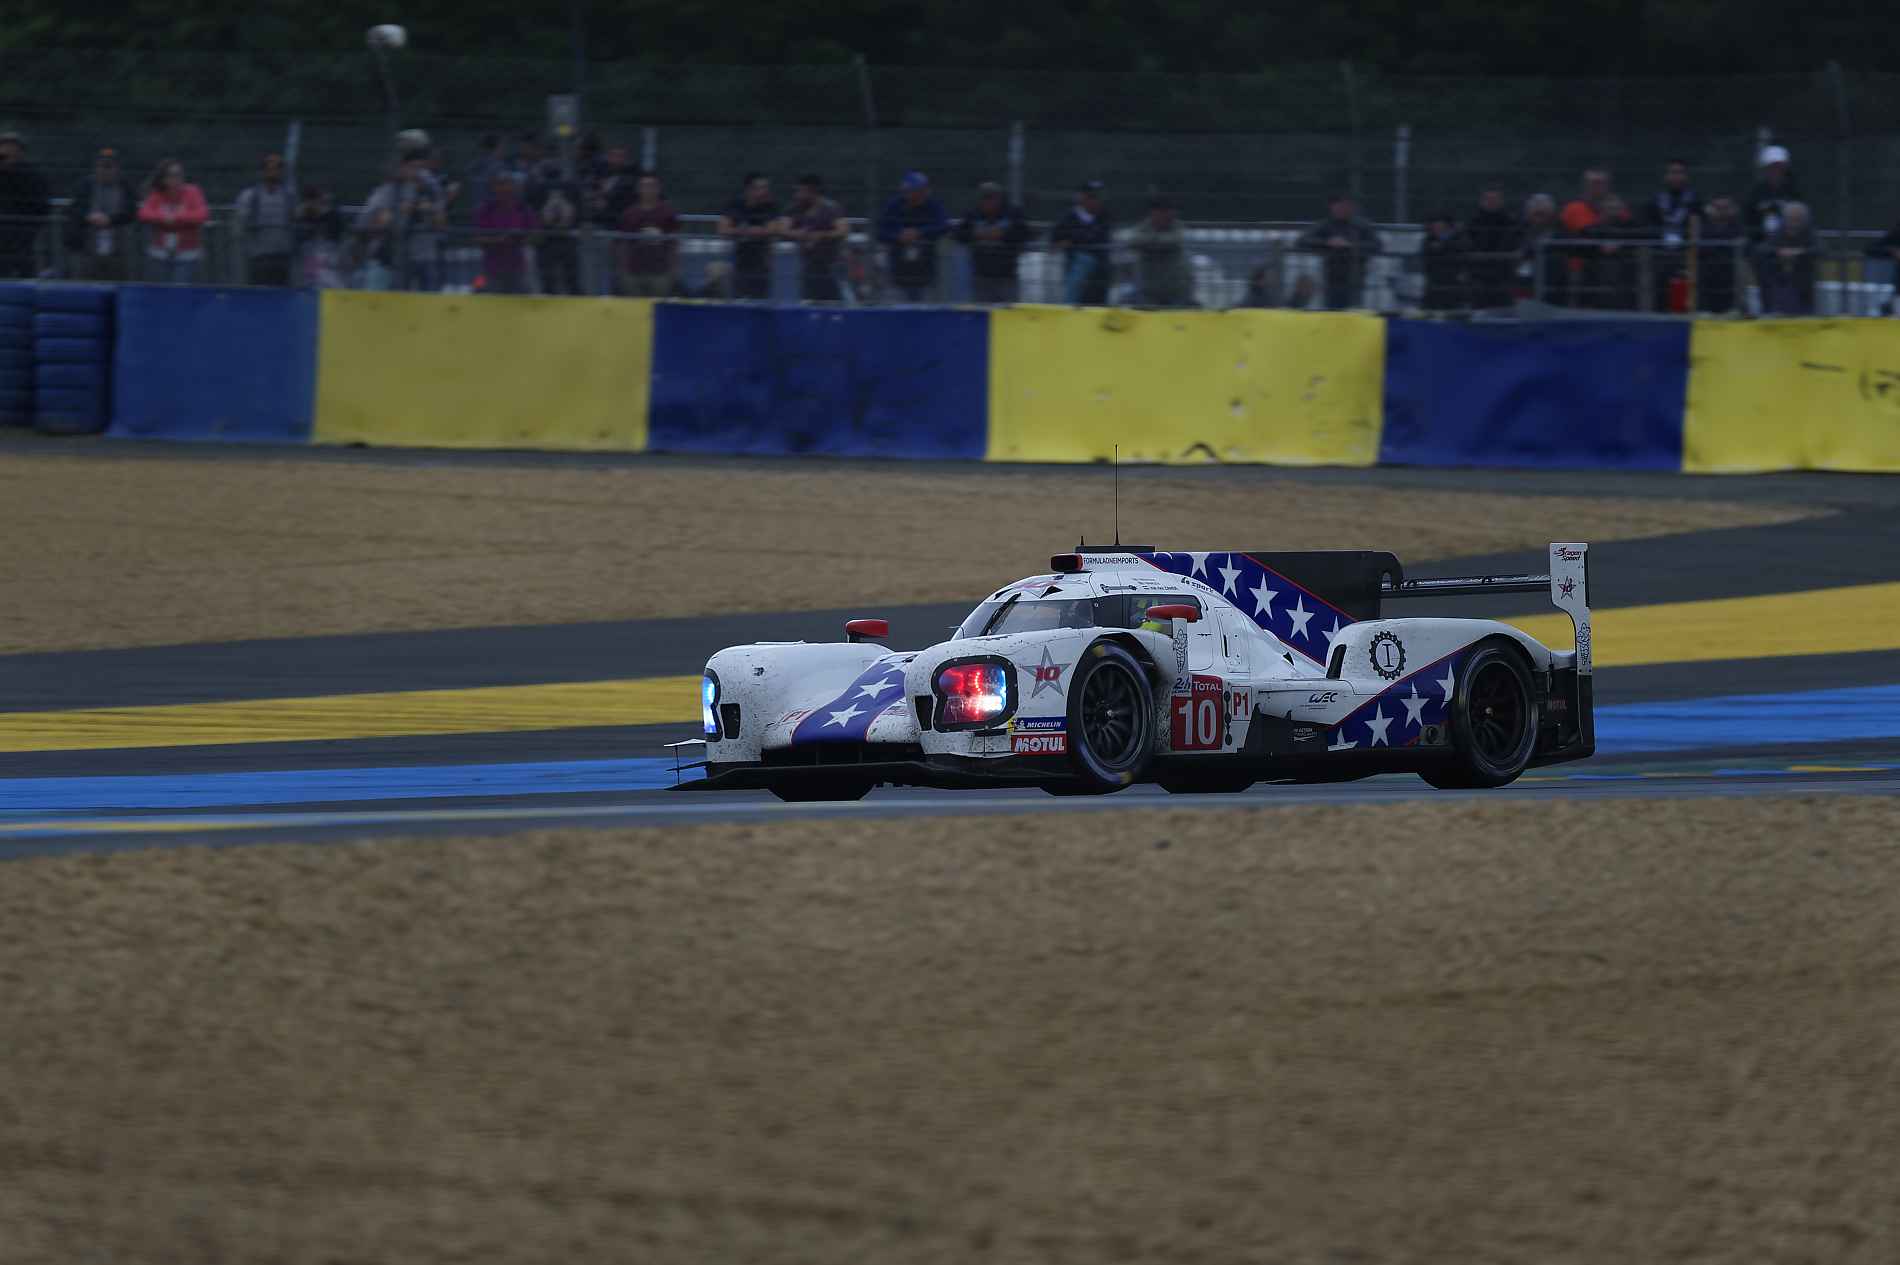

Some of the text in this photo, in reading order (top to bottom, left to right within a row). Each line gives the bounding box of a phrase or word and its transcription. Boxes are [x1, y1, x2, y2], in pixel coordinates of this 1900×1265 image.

[1036, 666, 1061, 681] 10
[1193, 681, 1222, 691] TOTAL
[1233, 691, 1249, 716] P1
[1309, 692, 1338, 703] WEC
[1026, 721, 1062, 729] MICHELIN
[1178, 699, 1217, 745] 10
[1015, 736, 1065, 752] MOTUL
